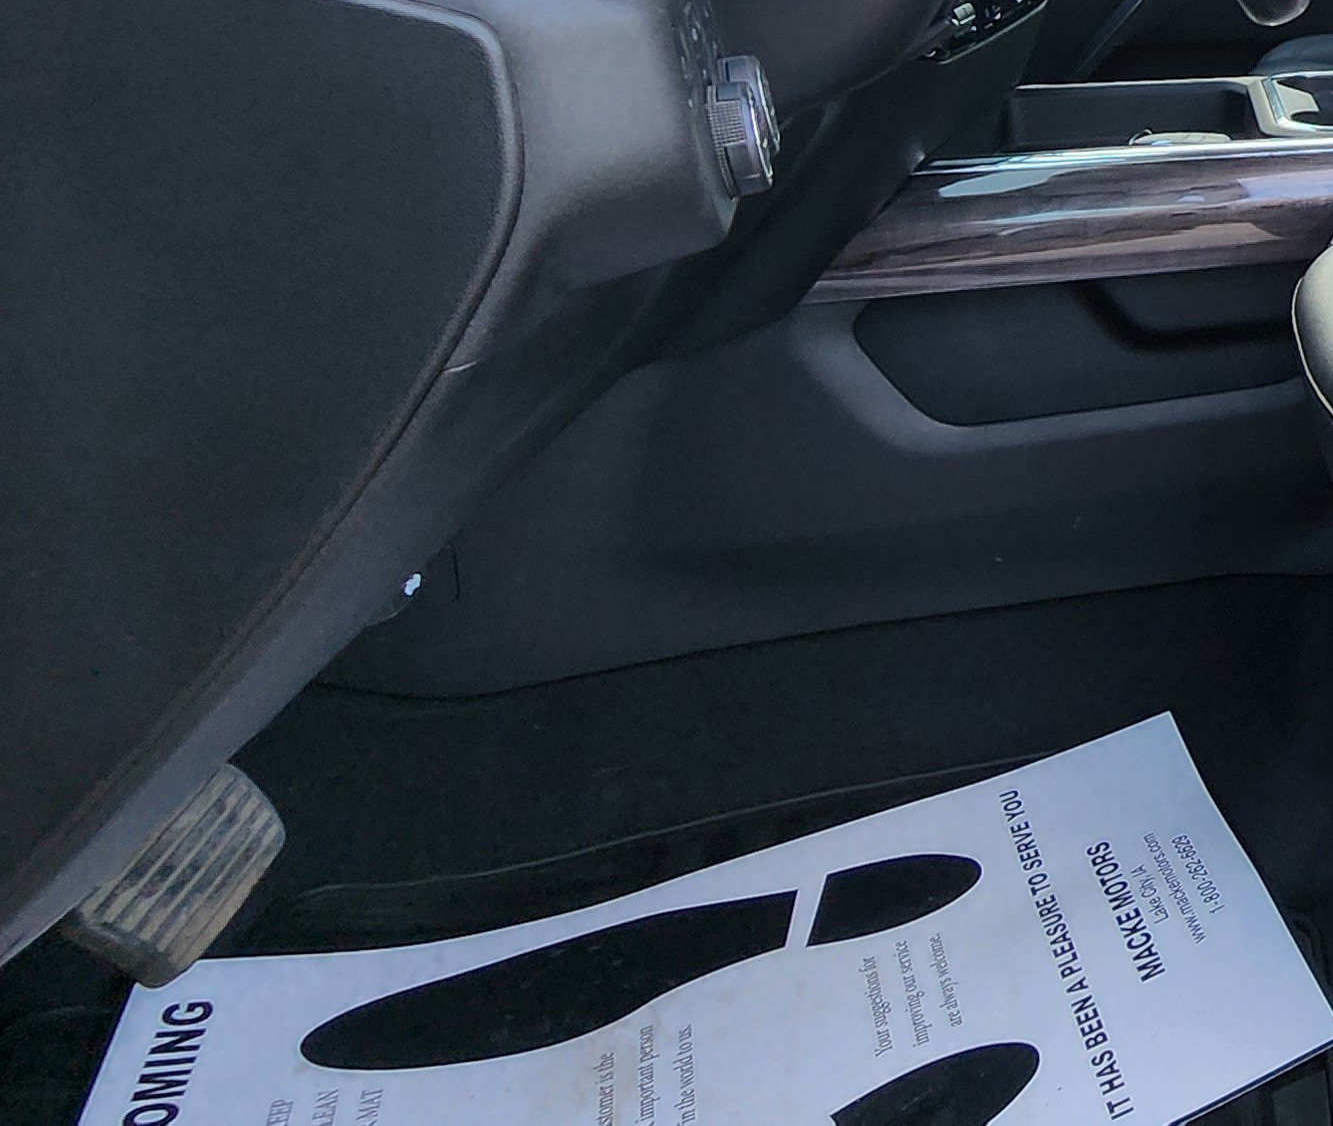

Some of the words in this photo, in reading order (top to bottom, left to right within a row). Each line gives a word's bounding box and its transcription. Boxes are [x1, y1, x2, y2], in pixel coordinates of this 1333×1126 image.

[999, 790, 1025, 822] YOU
[1010, 821, 1042, 871] SERVE
[1028, 873, 1051, 896] TO
[1087, 842, 1135, 911] MOTORS
[1131, 865, 1147, 878] IA
[1139, 875, 1157, 898] City,
[1172, 835, 1225, 914] 1-800-262-6629
[1144, 833, 1206, 944] www.mackemotors.com
[1149, 896, 1169, 924] Lake
[1035, 894, 1083, 979] PLEASURE
[1116, 907, 1165, 982] MACKE
[858, 956, 877, 973] for
[893, 940, 913, 974] service
[864, 970, 892, 1028] suggestions
[903, 975, 917, 993] our
[939, 977, 959, 1010] always
[1066, 977, 1089, 993] A
[905, 990, 933, 1048] improving
[948, 1010, 963, 1027] are
[1071, 995, 1108, 1050] BEEN
[640, 1025, 660, 1063] person
[677, 1042, 693, 1055] to
[874, 1028, 893, 1057] Your
[593, 1053, 614, 1072] the
[595, 1072, 614, 1084] is
[673, 1055, 694, 1089] world
[1091, 1050, 1125, 1095] HAS
[595, 1084, 614, 1126] stomer
[635, 1063, 660, 1124] important
[673, 1089, 695, 1110] the
[1106, 1097, 1134, 1120] IT
[676, 1109, 696, 1126] in
